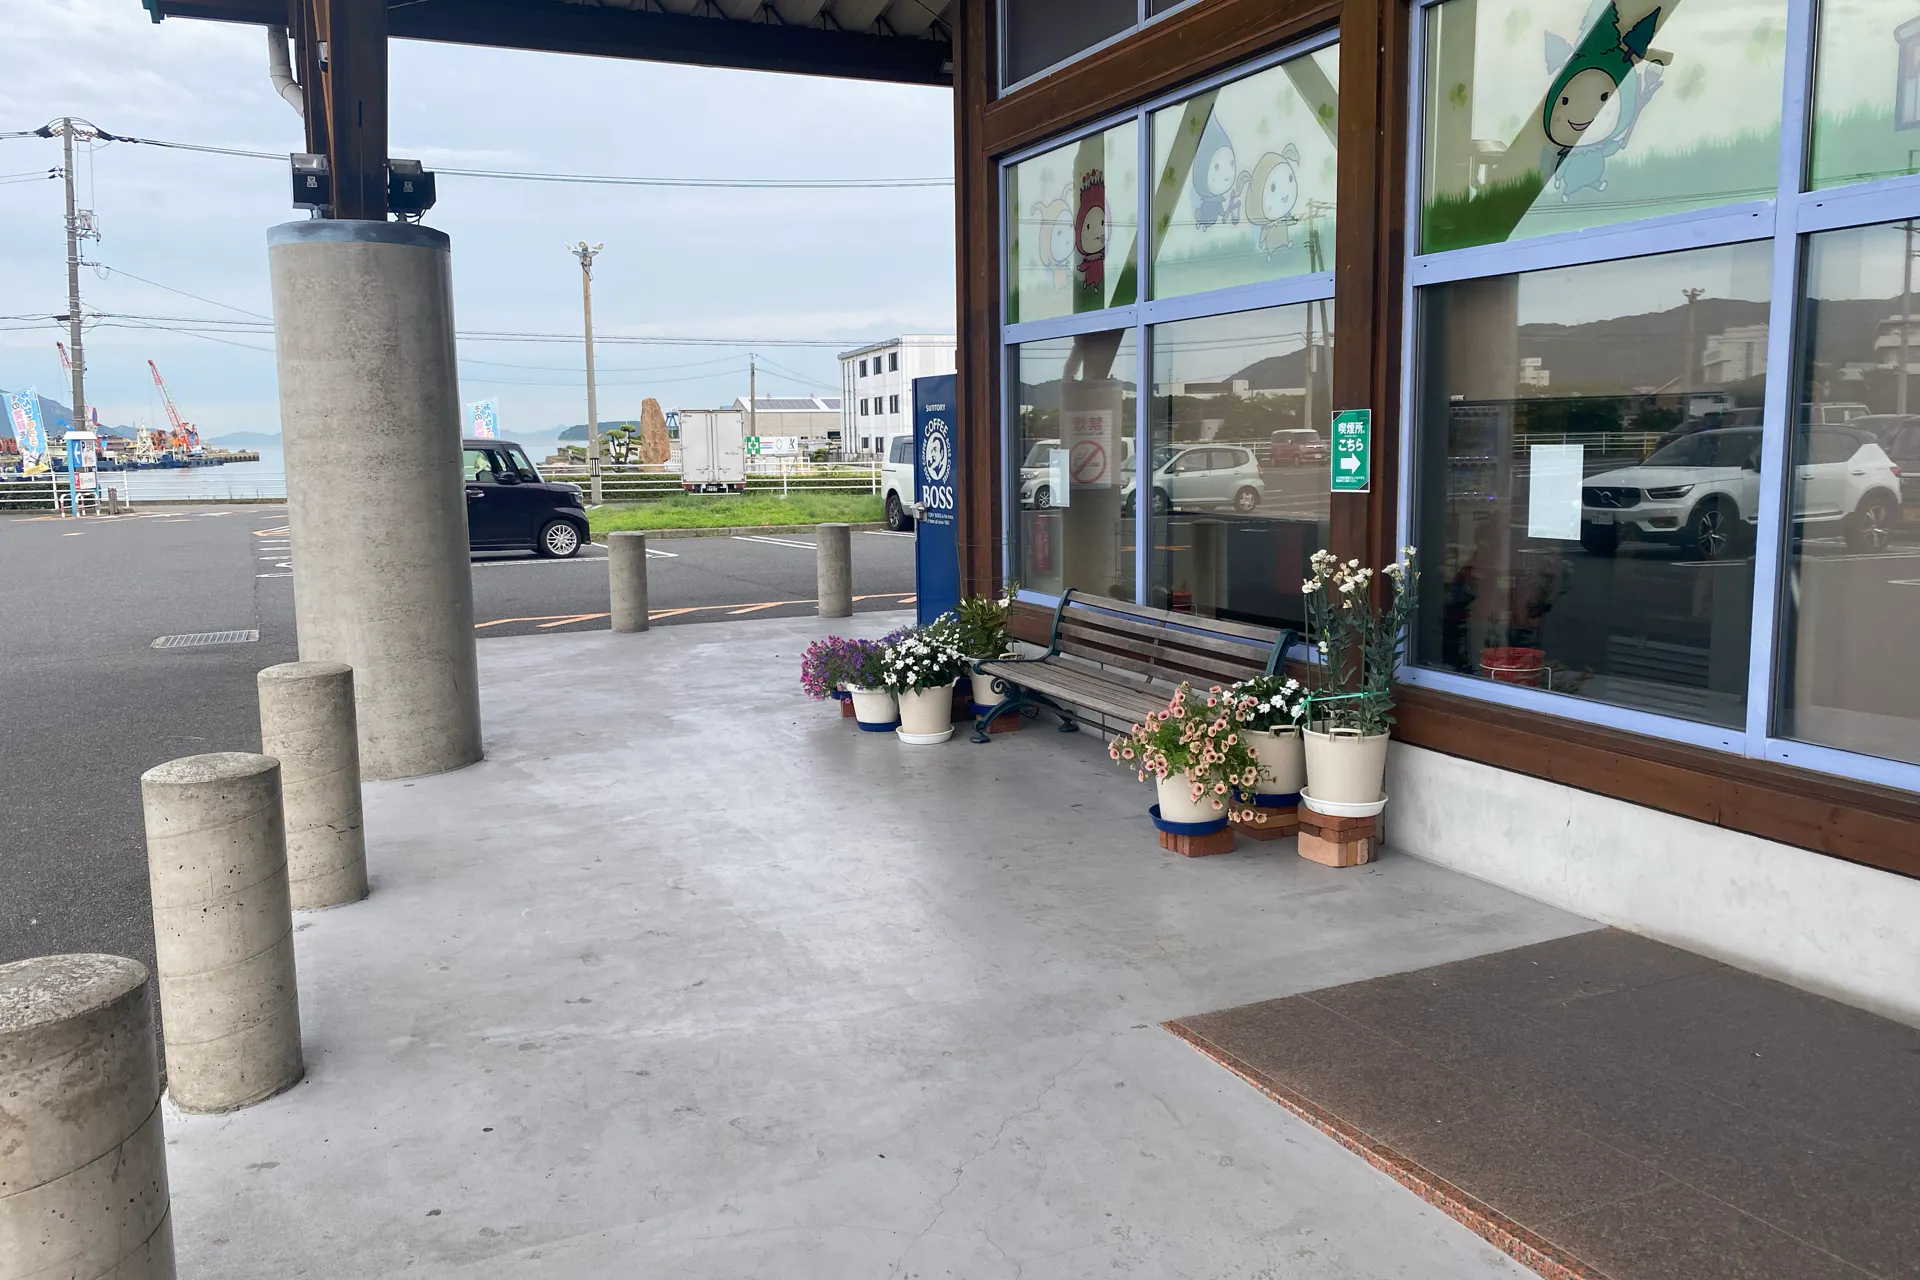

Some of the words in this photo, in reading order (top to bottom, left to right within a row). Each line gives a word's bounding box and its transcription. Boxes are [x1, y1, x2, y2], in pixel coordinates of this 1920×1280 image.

[925, 418, 949, 437] COFFEE
[1338, 438, 1364, 452] こちら
[922, 485, 953, 509] BOSS
